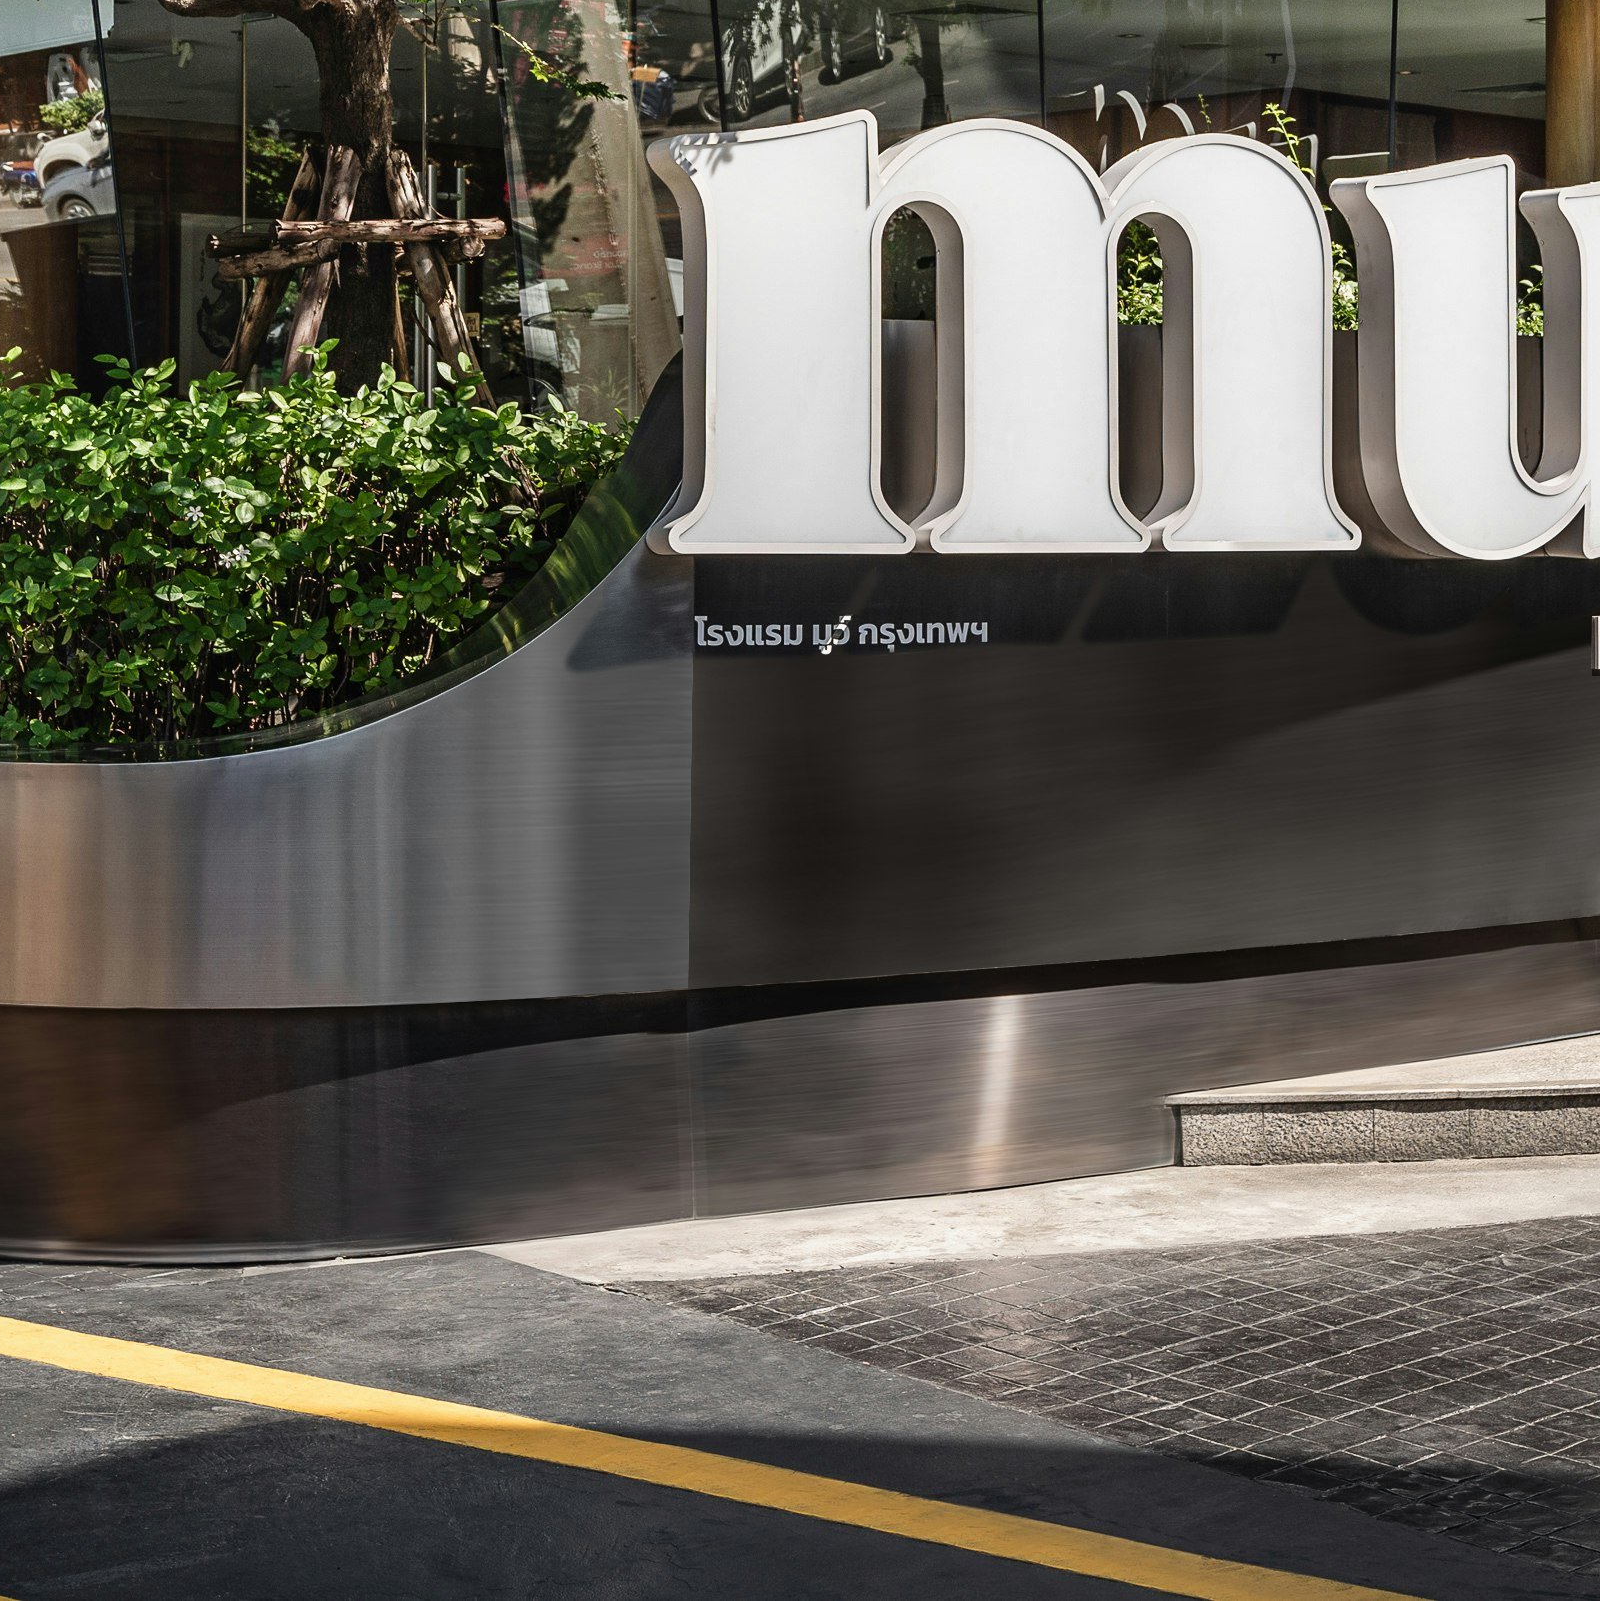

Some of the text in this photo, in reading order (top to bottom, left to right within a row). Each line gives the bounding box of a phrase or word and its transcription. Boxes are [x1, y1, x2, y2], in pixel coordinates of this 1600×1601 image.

[694, 615, 989, 655] โรงแรม มูว์ กรุงเทพฯ
